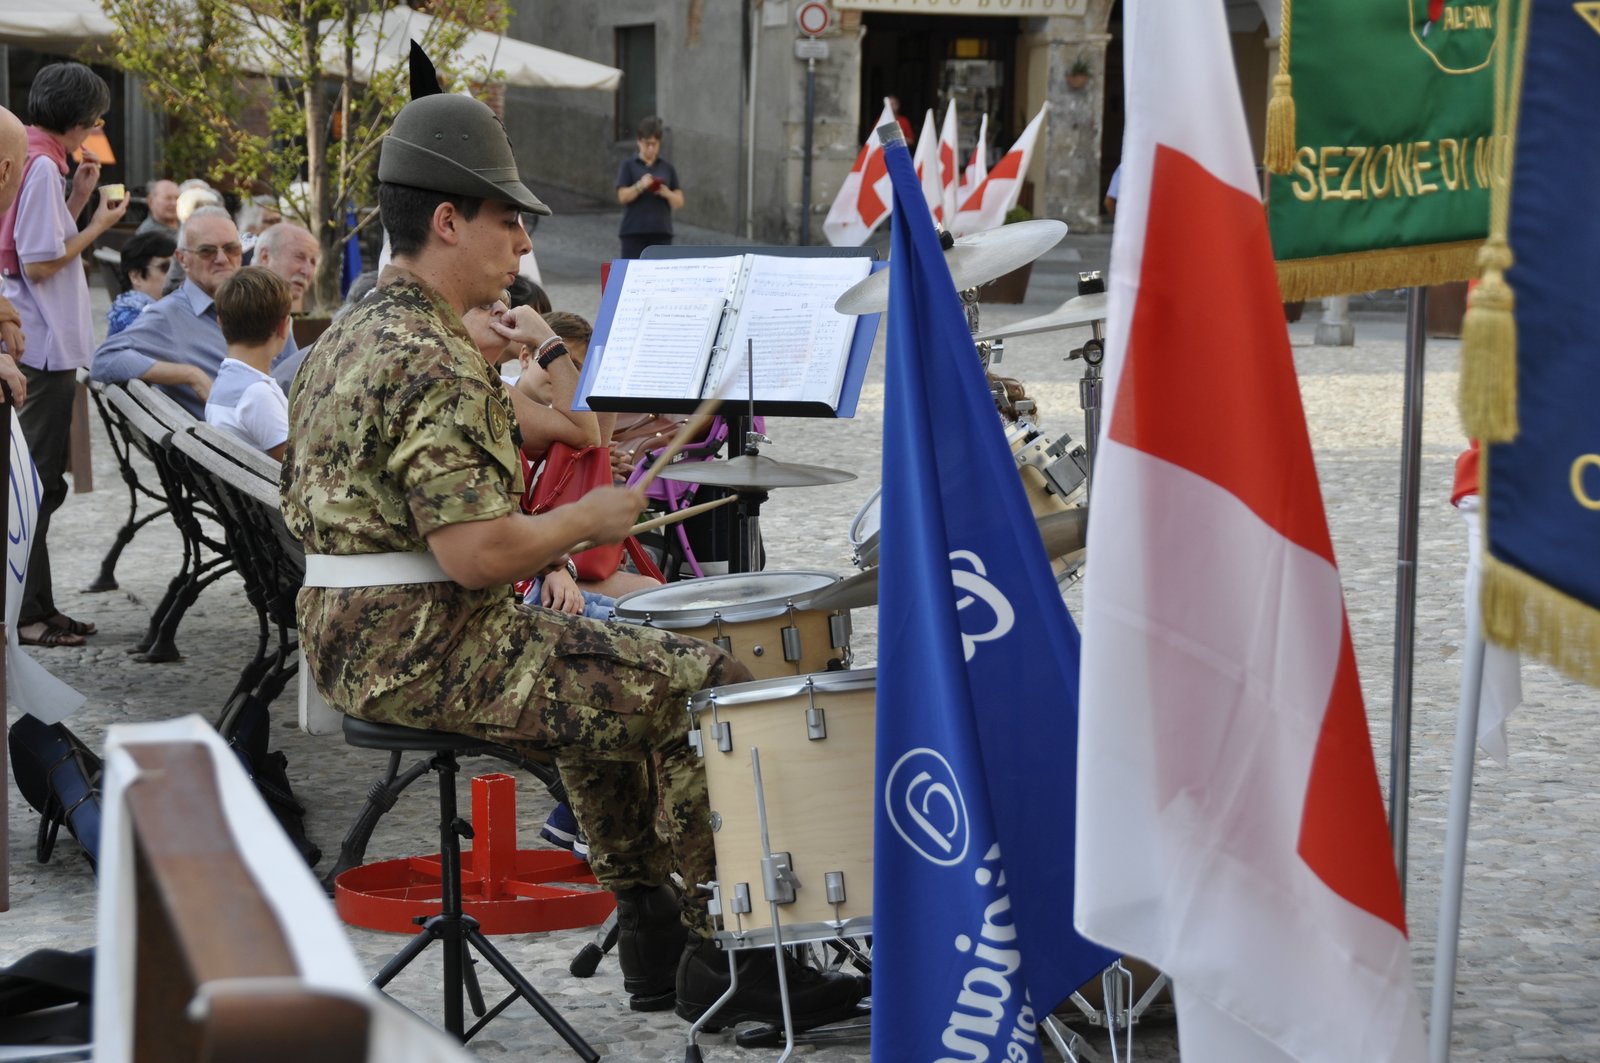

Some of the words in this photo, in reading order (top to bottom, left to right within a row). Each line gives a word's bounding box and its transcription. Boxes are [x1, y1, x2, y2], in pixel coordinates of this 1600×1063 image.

[1443, 5, 1492, 31] ALPINI
[1292, 141, 1438, 201] SEZIONE
[1439, 138, 1470, 191] DI
